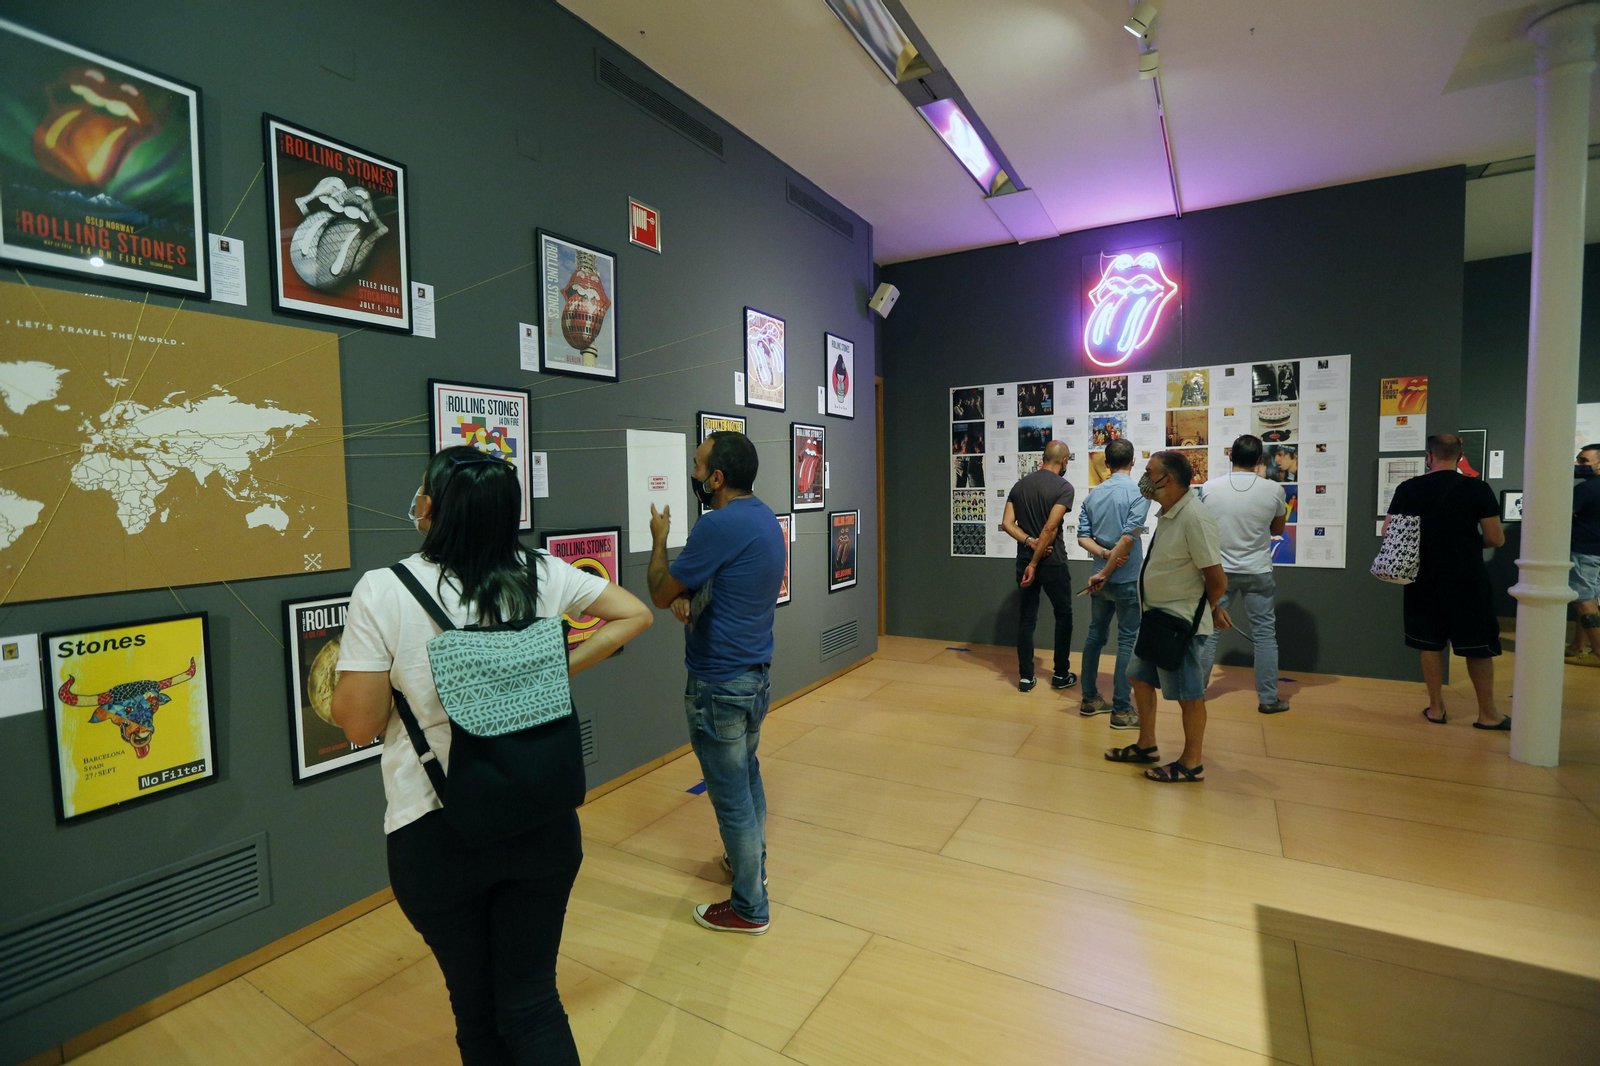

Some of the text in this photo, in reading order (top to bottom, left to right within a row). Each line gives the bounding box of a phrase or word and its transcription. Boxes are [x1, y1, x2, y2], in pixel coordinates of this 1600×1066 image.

[285, 134, 343, 172] ROLLING
[347, 156, 394, 188] STONES
[85, 215, 135, 234] OSLO NORWAY
[21, 209, 110, 250] ROLLING
[117, 232, 187, 266] STONES
[80, 245, 143, 266] 14 ON FIRE
[546, 243, 559, 284] ROLLING
[358, 279, 399, 294] TELE2 ARENA
[358, 288, 399, 305] STOCKHOLM
[359, 301, 375, 310] JULY
[385, 306, 400, 314] 2014
[547, 284, 560, 319] STONES
[16, 319, 177, 346] LET'S TRAVEL THE WORLD
[566, 354, 581, 364] BERLIN
[448, 395, 486, 415] ROLLING
[487, 399, 519, 417] STONES
[503, 417, 511, 426] ON
[510, 417, 520, 427] FIRE
[556, 540, 585, 557] ROLLING
[586, 538, 612, 554] STONES
[305, 605, 349, 632] ROLLIN
[316, 629, 327, 637] FIRE
[57, 633, 147, 659] Stones
[141, 762, 205, 788] No Filter
